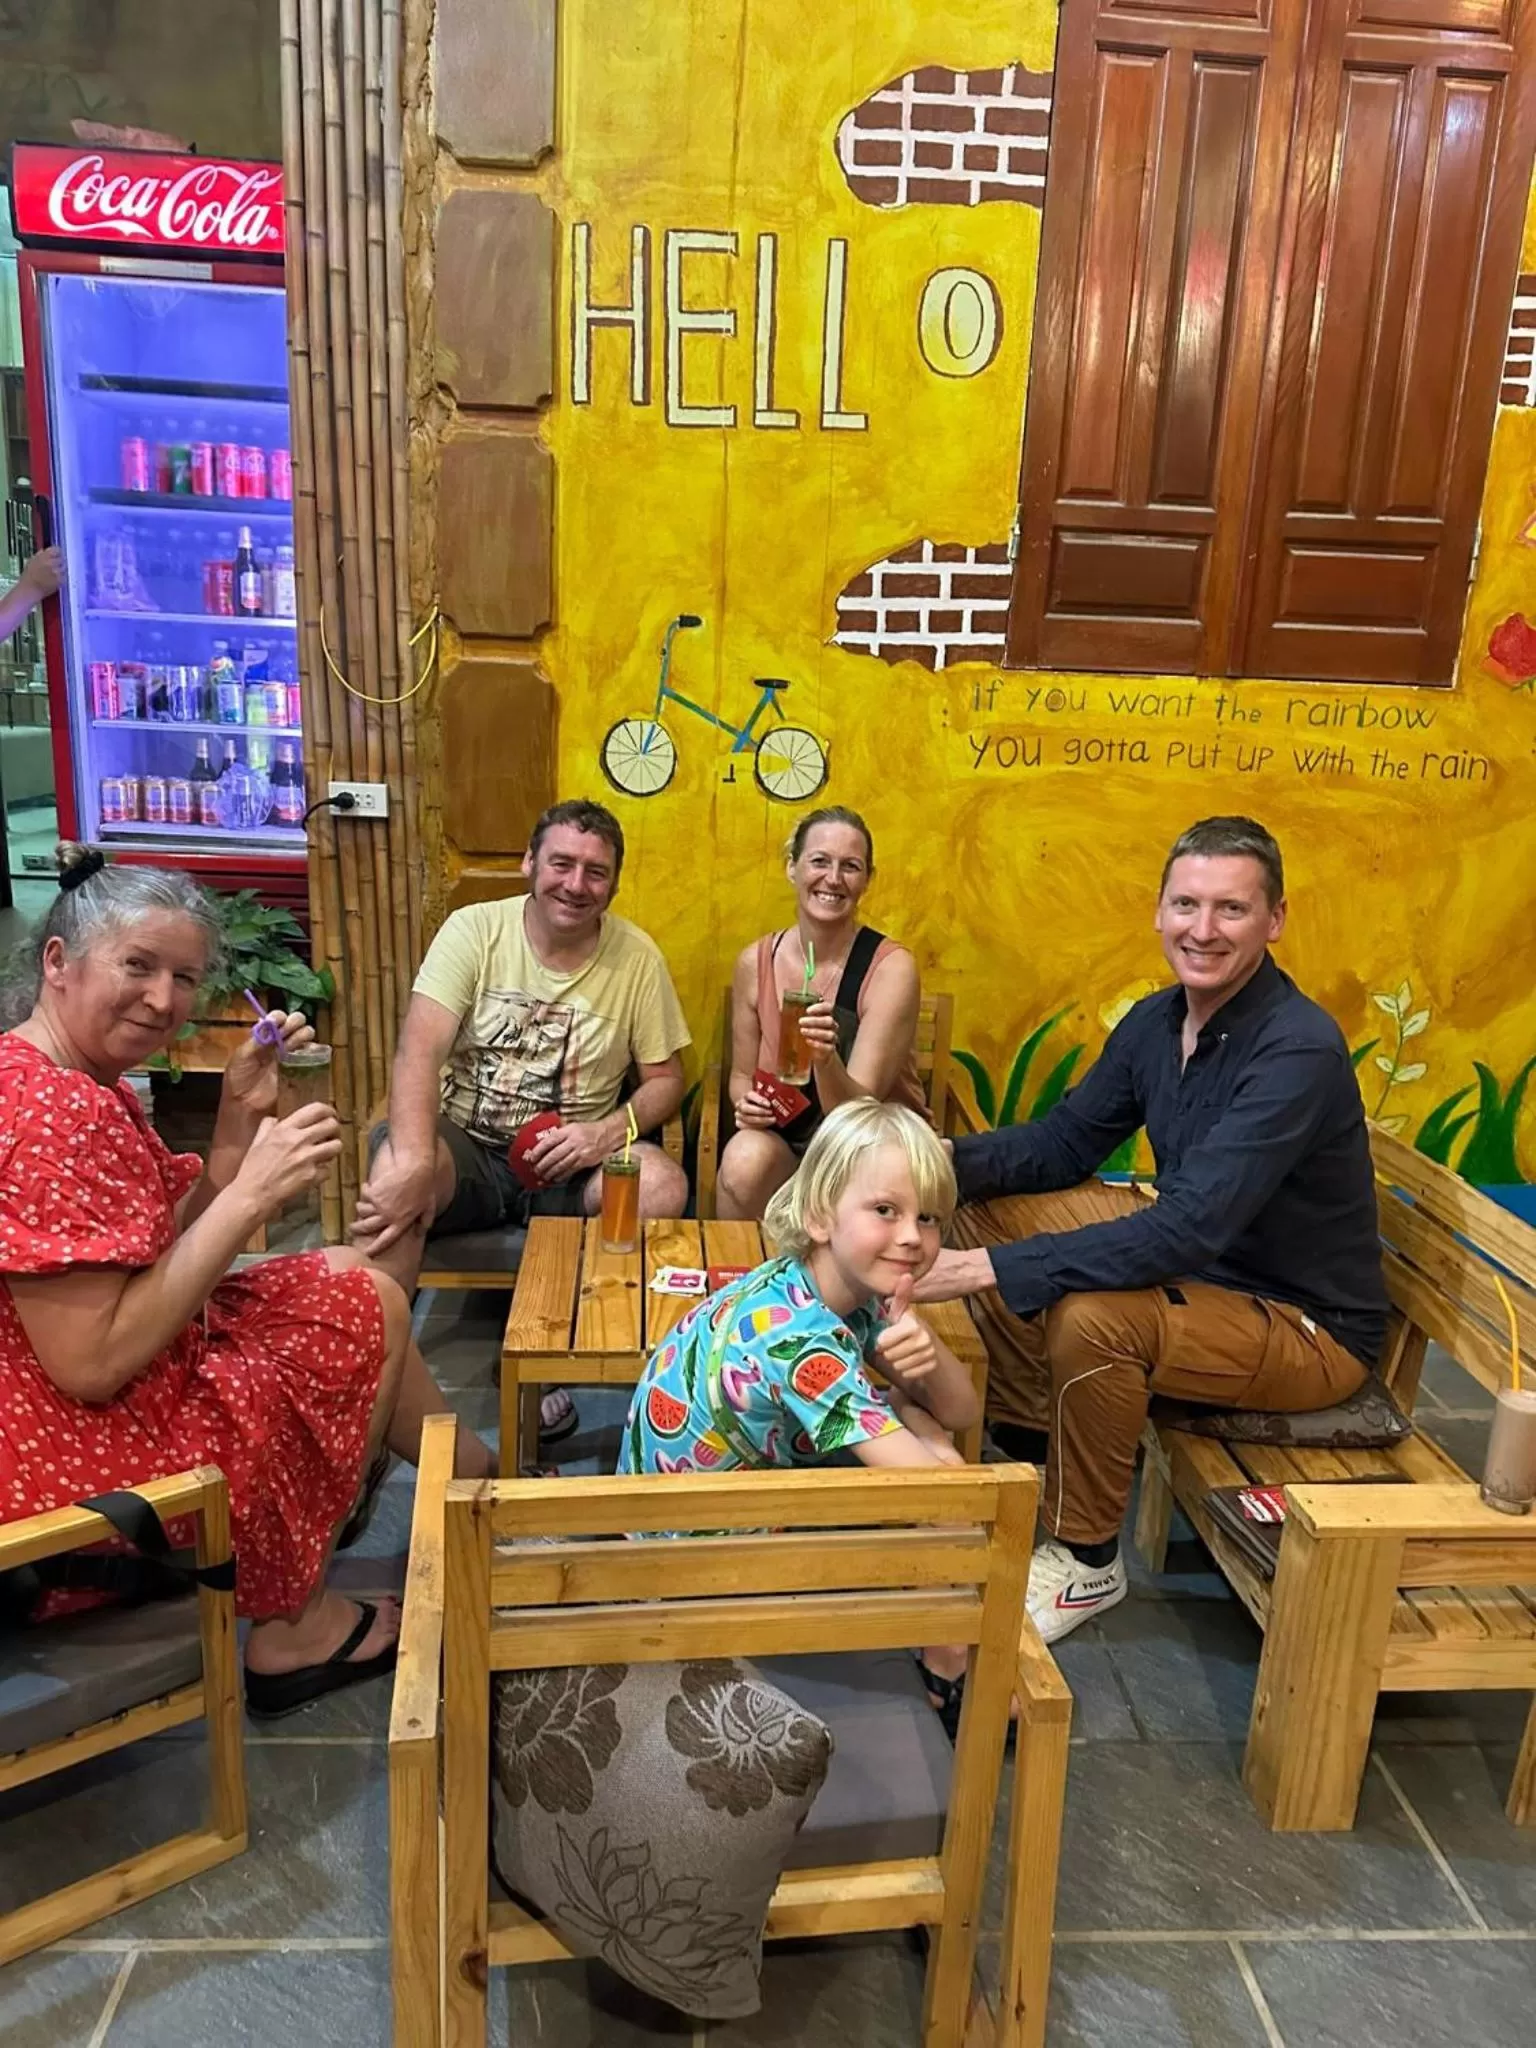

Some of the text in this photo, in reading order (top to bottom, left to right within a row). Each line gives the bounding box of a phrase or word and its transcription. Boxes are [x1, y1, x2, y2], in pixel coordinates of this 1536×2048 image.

[48, 154, 283, 247] Coca-Cola
[571, 222, 1004, 431] HELLO
[1026, 687, 1086, 712] you
[1108, 691, 1197, 717] want
[1215, 694, 1262, 723] the
[1286, 696, 1438, 730] rainbow
[1063, 738, 1151, 766] gotta
[1370, 747, 1410, 780] the
[1421, 749, 1490, 781] rain
